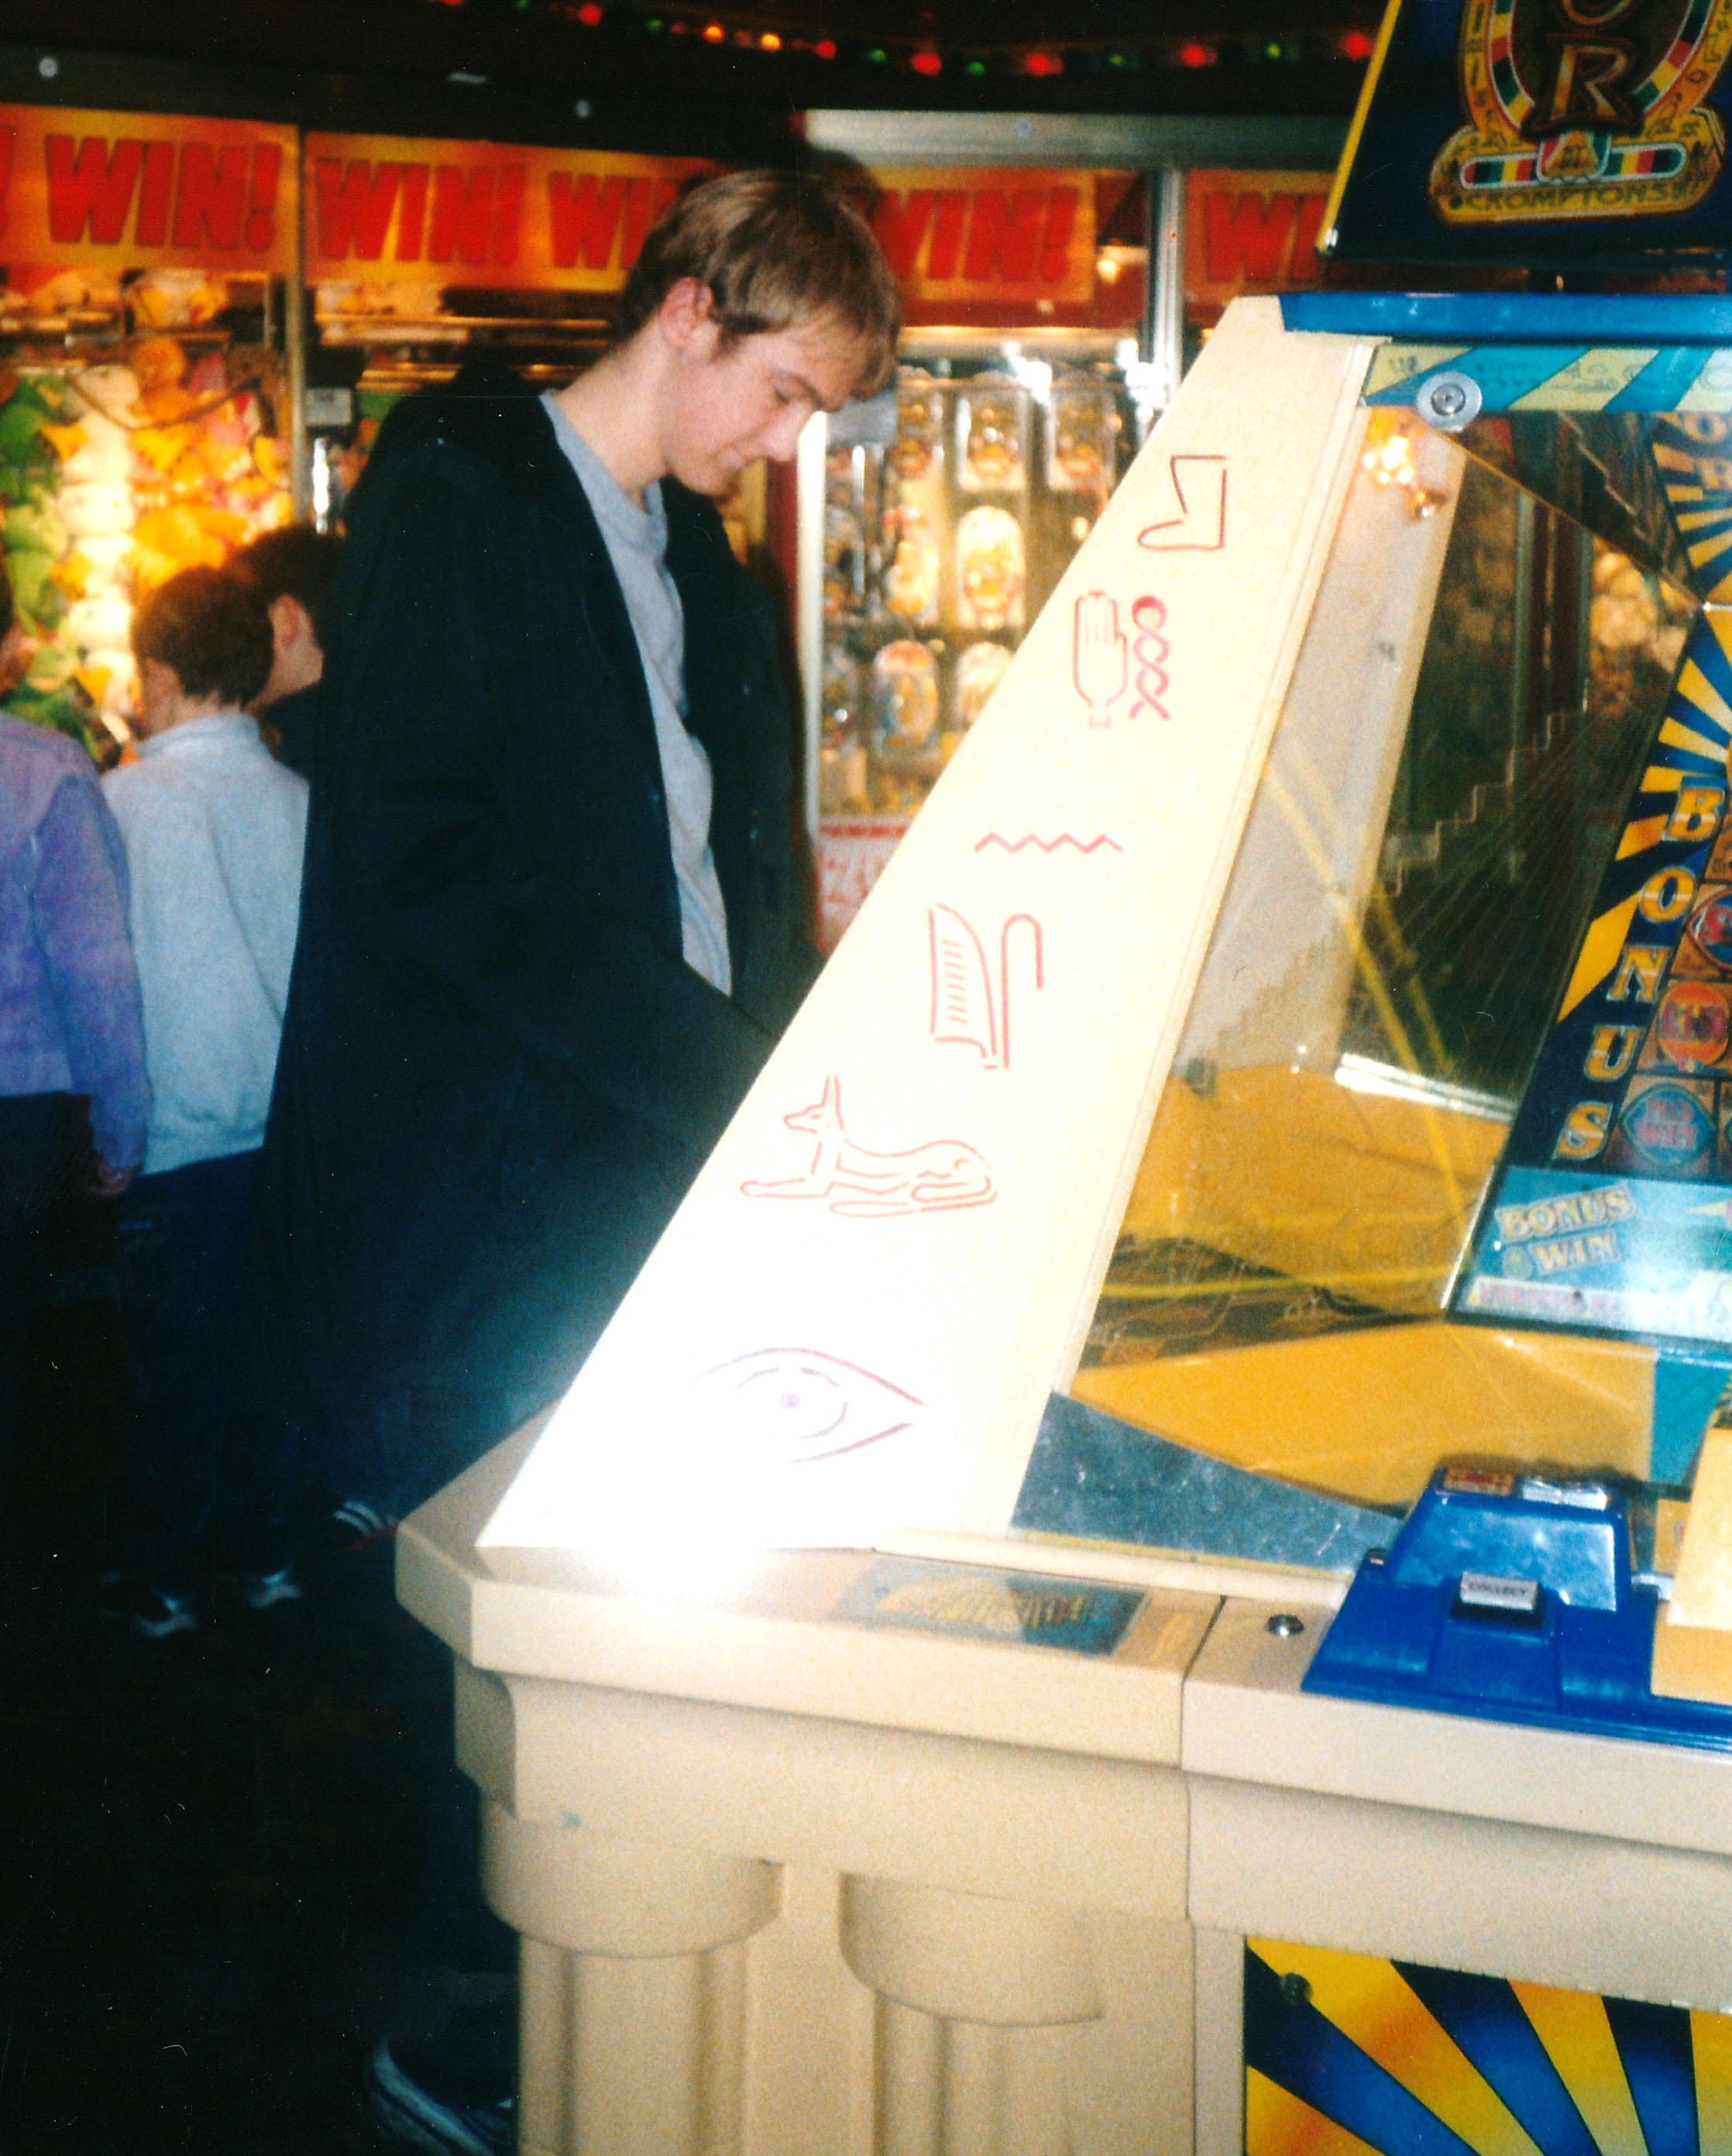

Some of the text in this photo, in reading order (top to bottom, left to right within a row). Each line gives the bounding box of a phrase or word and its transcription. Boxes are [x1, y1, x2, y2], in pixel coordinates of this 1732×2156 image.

[44, 133, 284, 253] WIN!
[315, 157, 679, 270] WIN! WI
[1205, 192, 1328, 283] WI
[1552, 786, 1727, 1161] BONUS
[1637, 1121, 1696, 1148] WIN
[1647, 1098, 1692, 1121] NO
[1499, 1186, 1629, 1240] BONUS
[1531, 1233, 1616, 1272] WIN
